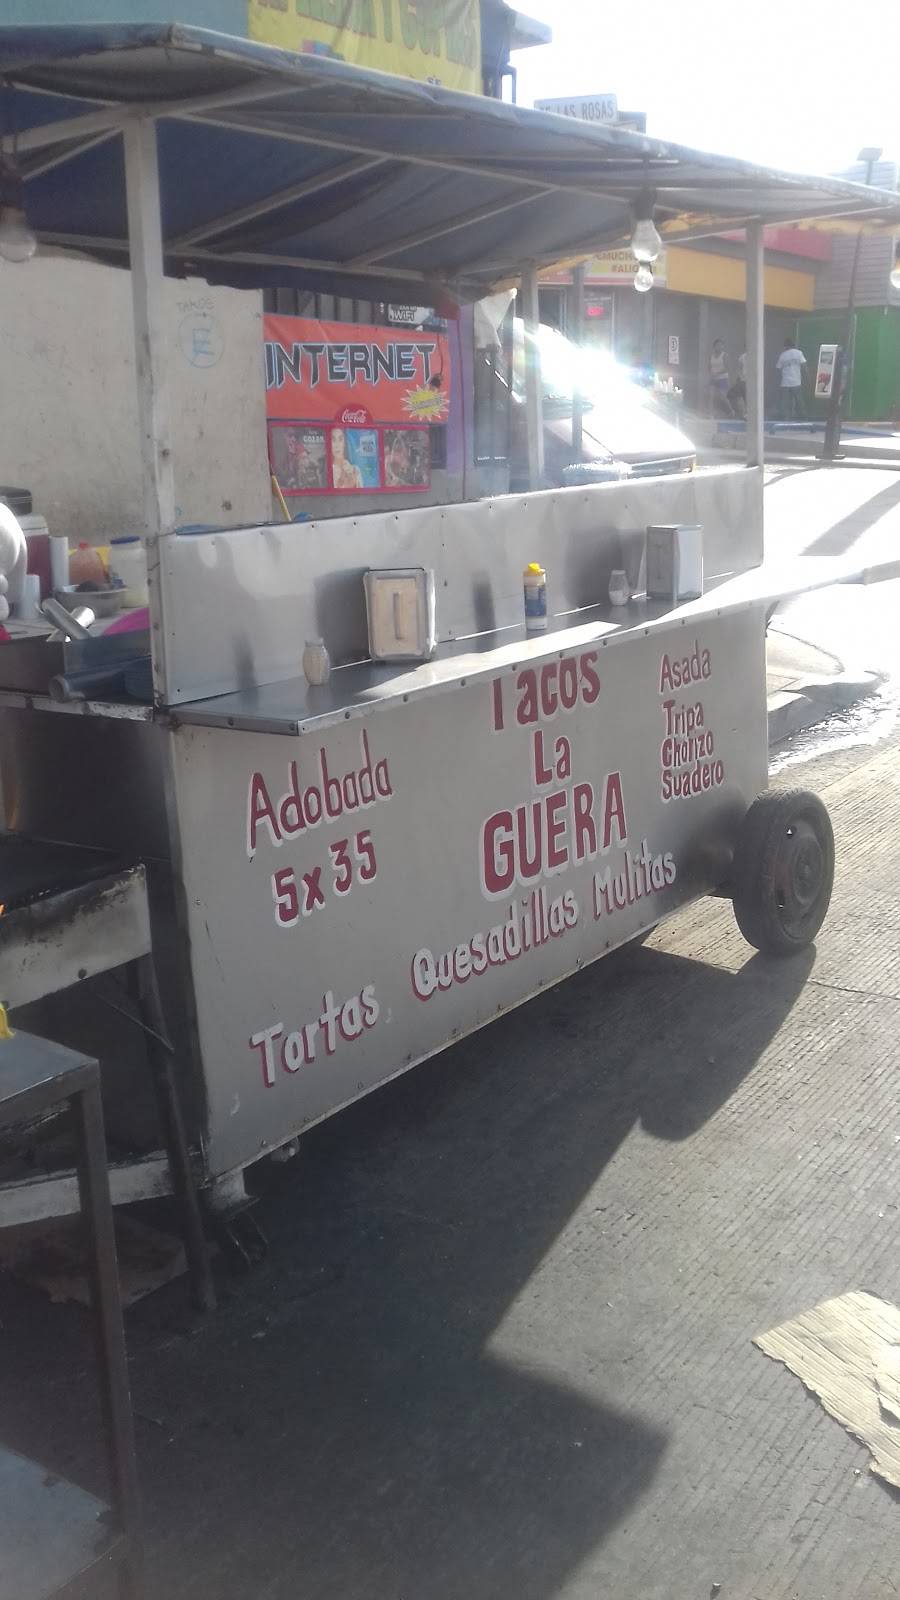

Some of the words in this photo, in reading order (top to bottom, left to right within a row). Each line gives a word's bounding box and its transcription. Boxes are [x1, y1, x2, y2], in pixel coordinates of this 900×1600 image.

[582, 101, 614, 120] ROSAS
[264, 343, 437, 390] INTERNET
[659, 640, 712, 694] Asada
[662, 699, 705, 737] Tripa
[531, 729, 573, 789] La
[660, 730, 715, 769] Chorizo
[247, 728, 393, 857] Adobada
[660, 759, 725, 803] Suadero
[480, 770, 628, 902] GUERA
[249, 984, 380, 1088] Tortas
[411, 884, 579, 1001] Quesadillas
[592, 838, 677, 921] Mulitas
